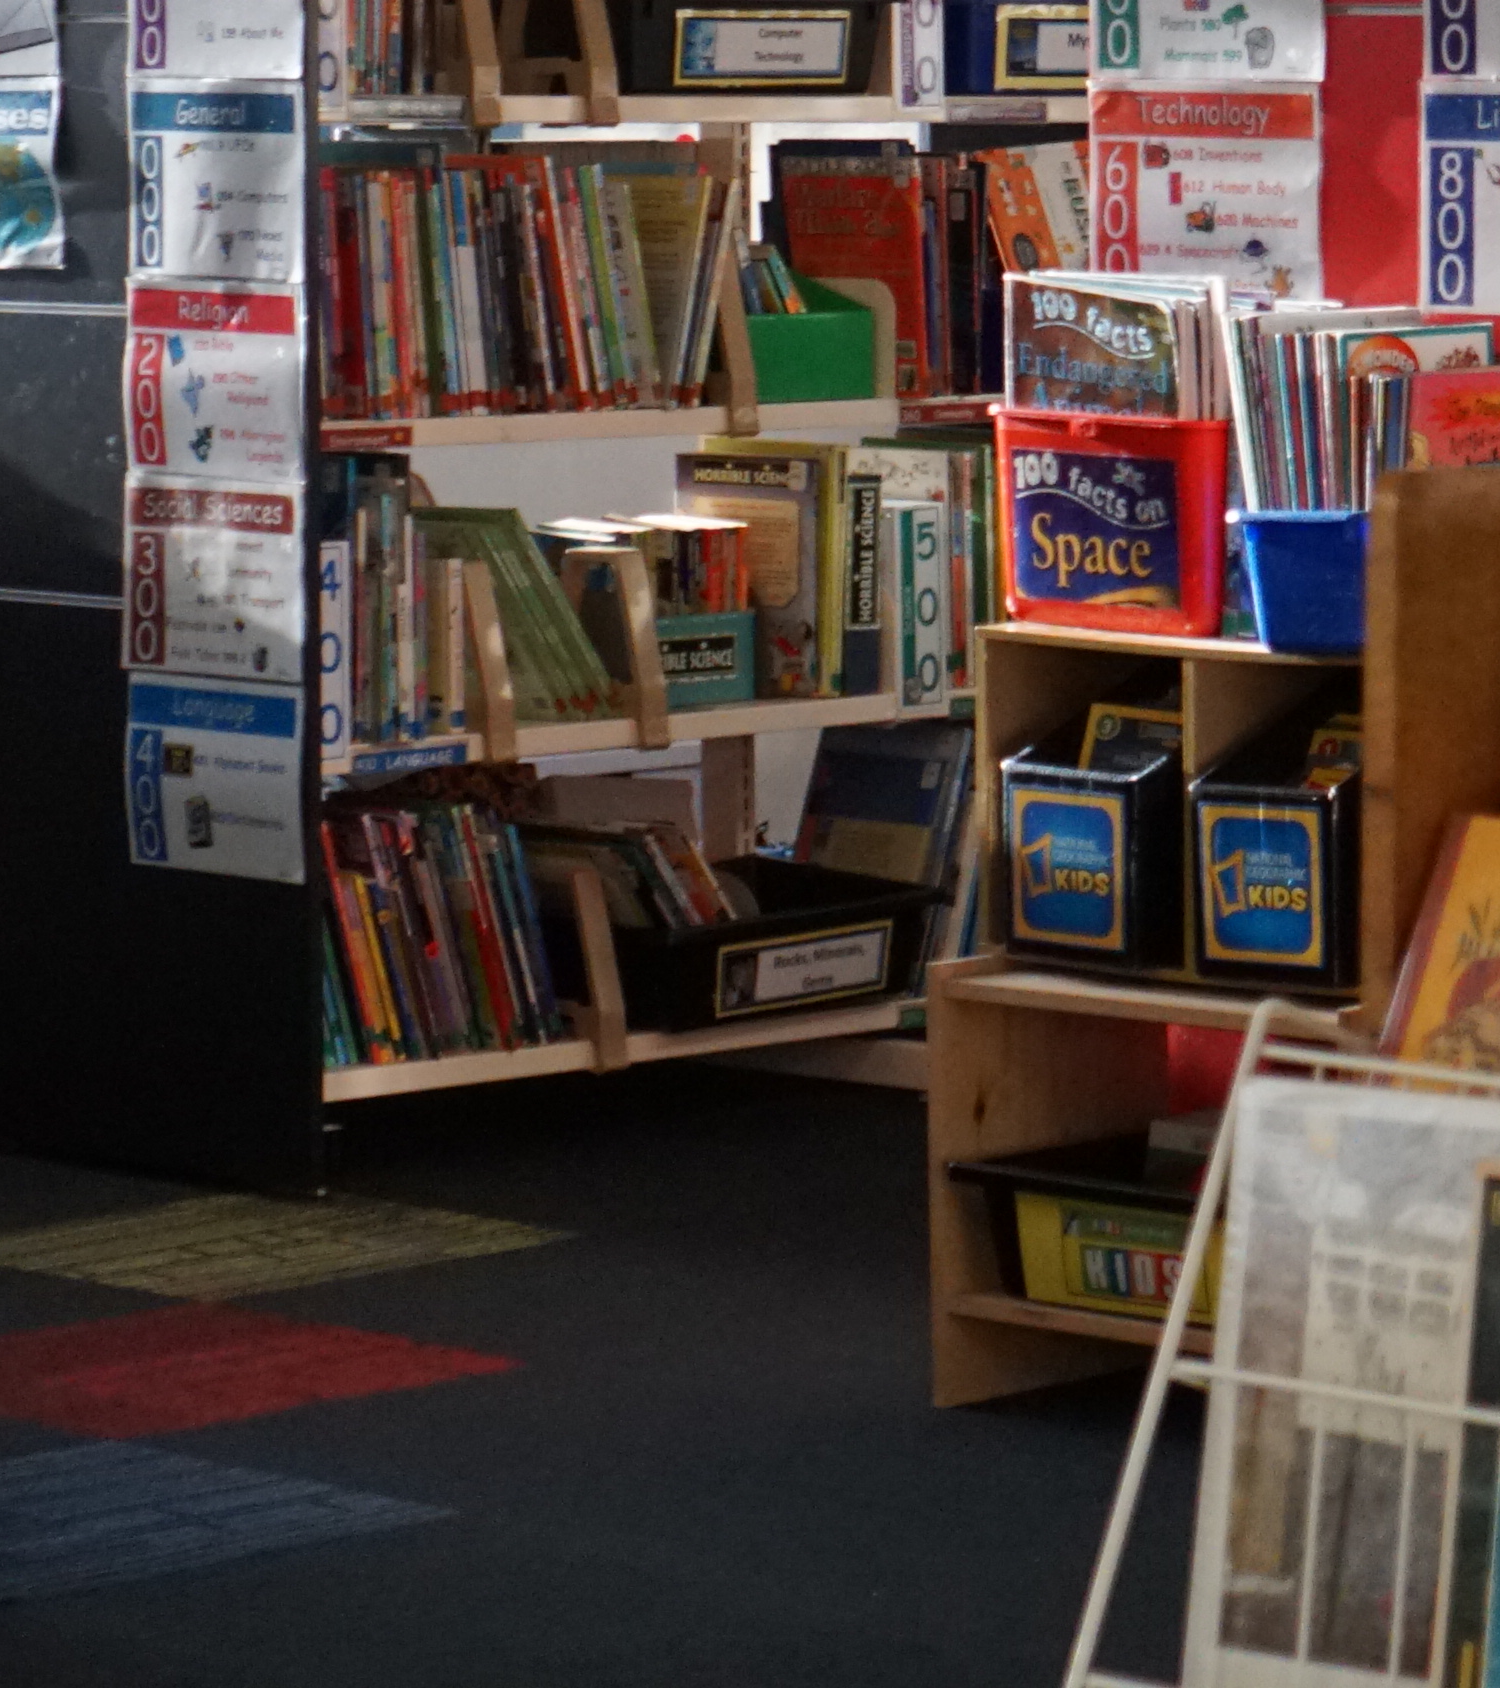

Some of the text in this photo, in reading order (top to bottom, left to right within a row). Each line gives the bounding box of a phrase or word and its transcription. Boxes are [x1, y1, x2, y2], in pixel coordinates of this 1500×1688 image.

[758, 28, 804, 42] Computer
[1159, 15, 1197, 32] Plants
[754, 50, 804, 64] Technology
[175, 98, 247, 126] General
[1136, 95, 1270, 135] Technology
[1198, 146, 1262, 162] Inventions
[1212, 181, 1252, 195] Human
[1256, 181, 1286, 197] Body
[1241, 214, 1299, 229] Machines
[1437, 151, 1465, 302] 800
[1177, 244, 1241, 259] Spacecraft
[178, 295, 249, 330] Religion
[1031, 290, 1154, 354] 100 facts
[1017, 341, 1169, 396] Endangered
[693, 467, 751, 484] HORRIBLE
[1013, 452, 1168, 523] 100 facts on
[143, 492, 284, 526] Social Sciences
[857, 488, 876, 623] HORRIBLE SCIENCE
[1031, 512, 1153, 589] Space
[690, 649, 733, 668] SCIENCE
[385, 749, 454, 771] LANGUAGE
[1054, 868, 1111, 897] KIDS
[1248, 884, 1309, 911] KIDS
